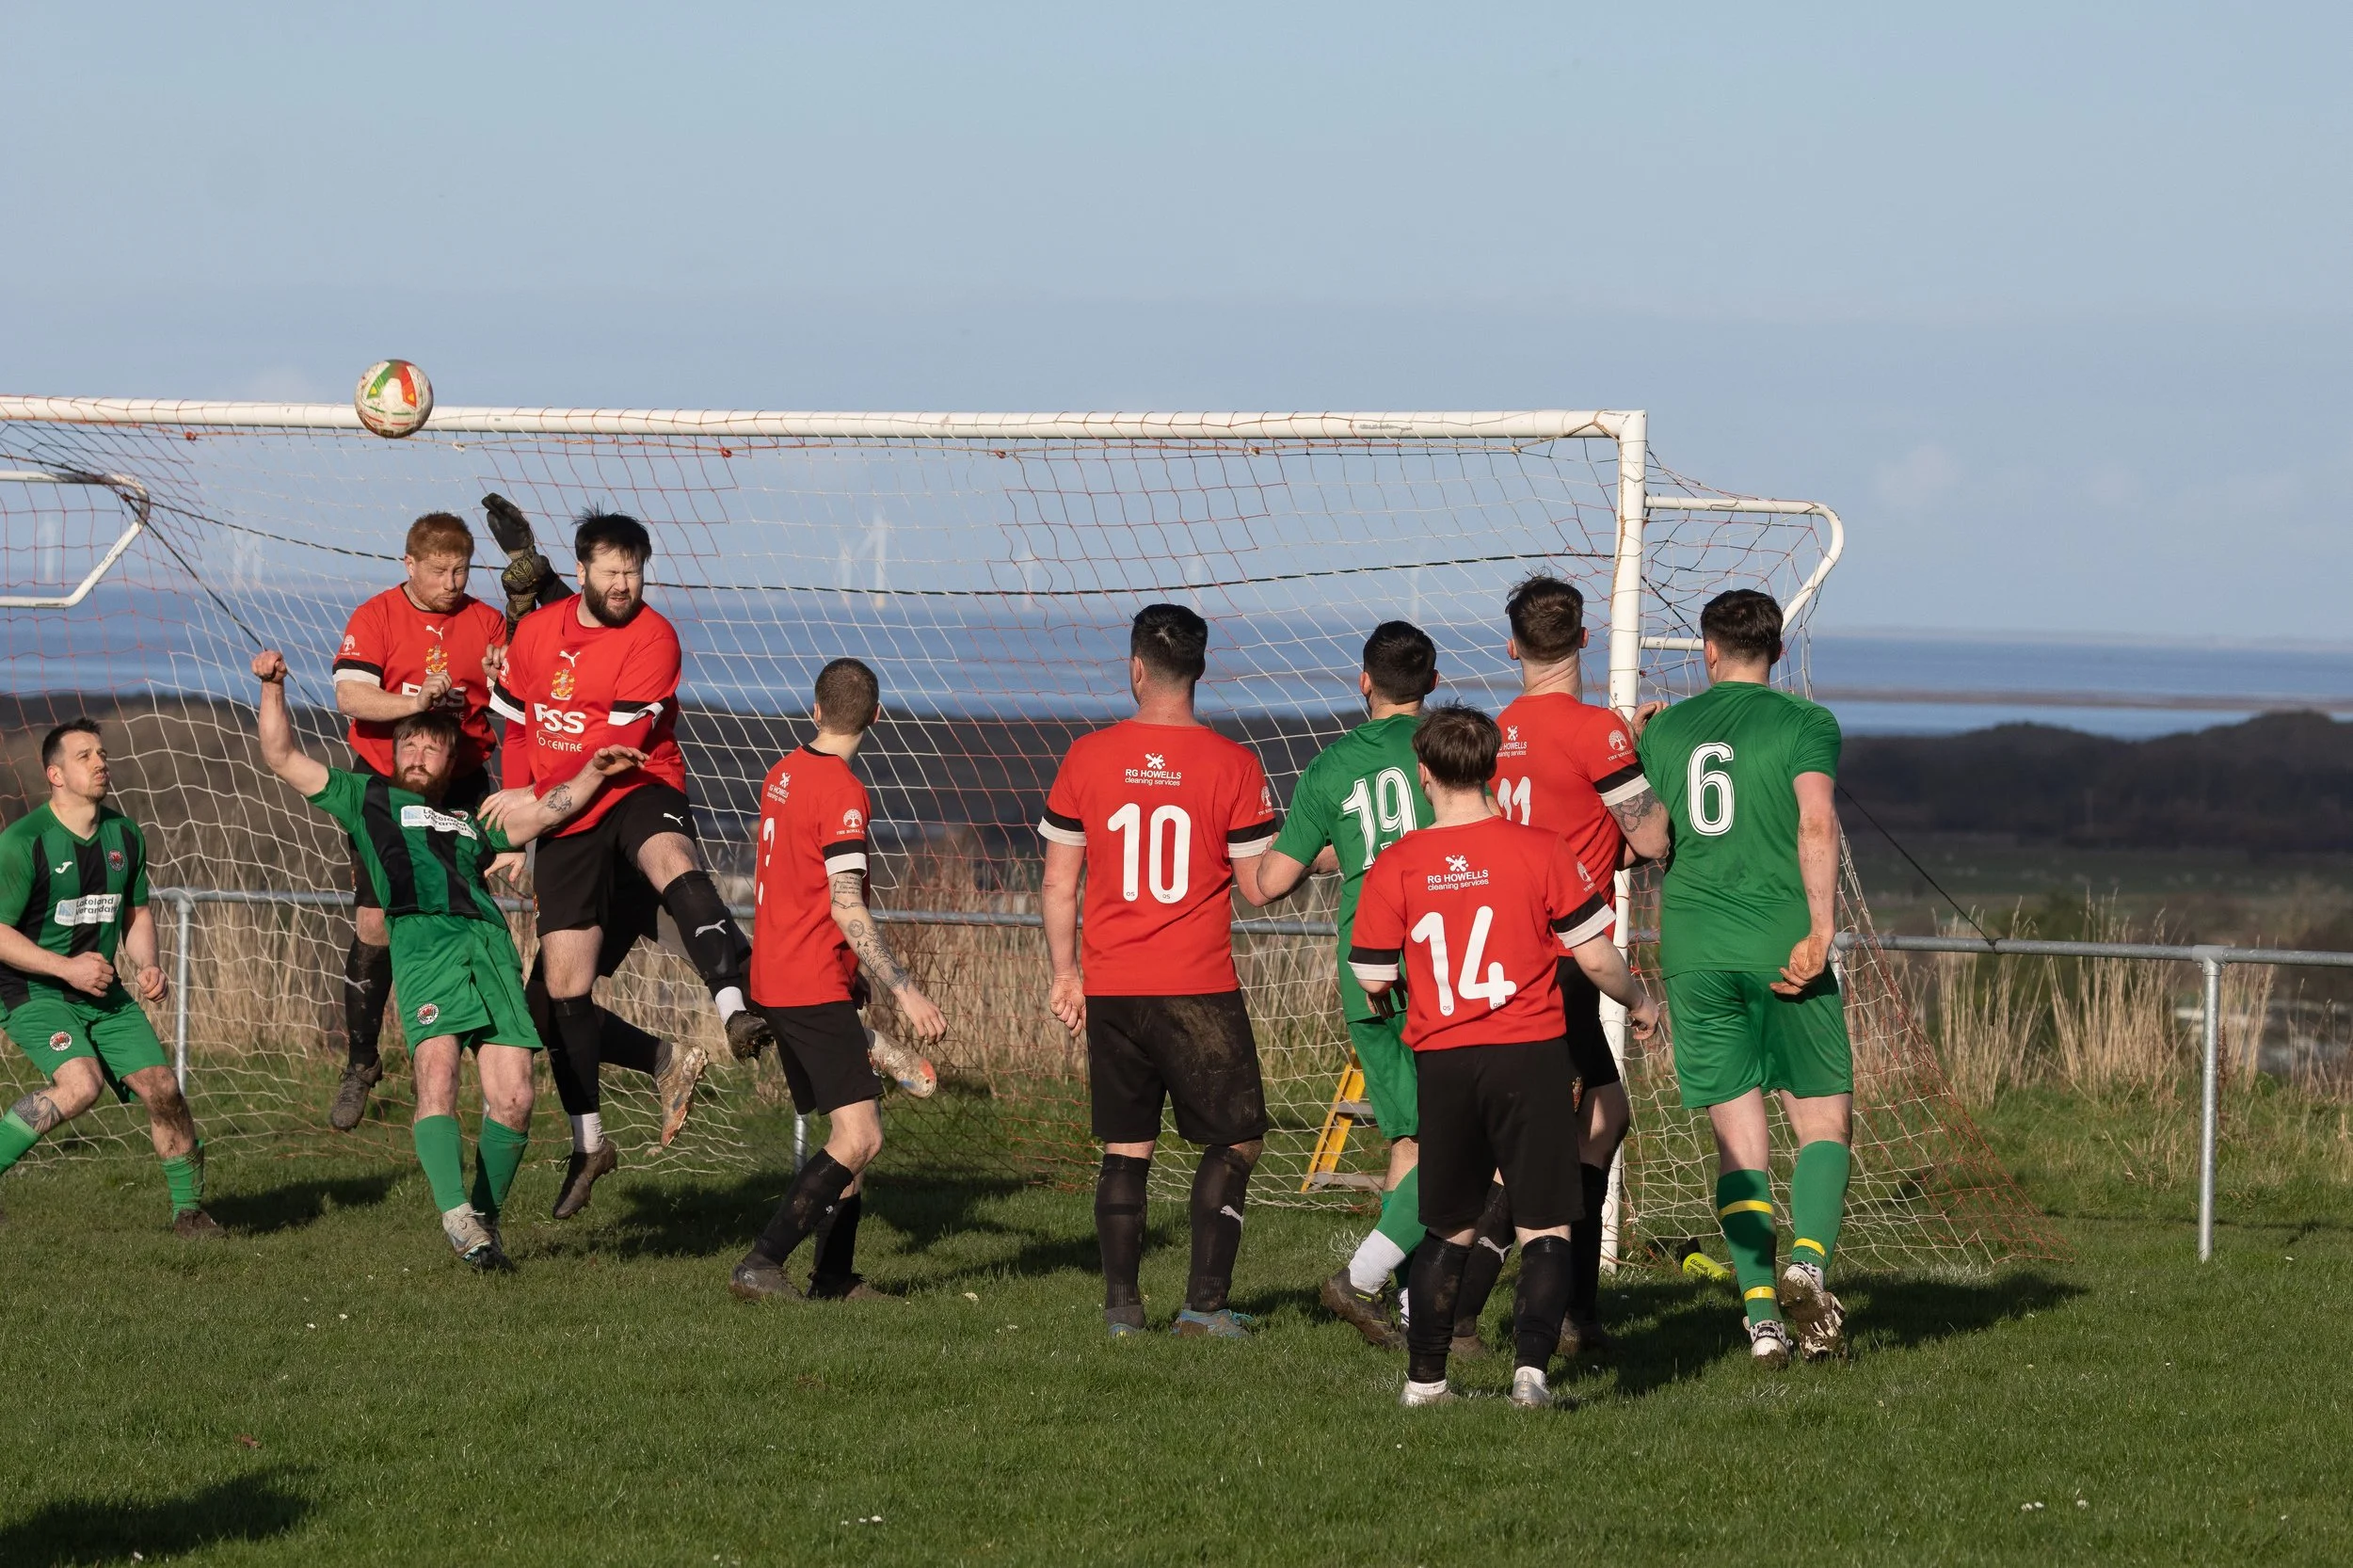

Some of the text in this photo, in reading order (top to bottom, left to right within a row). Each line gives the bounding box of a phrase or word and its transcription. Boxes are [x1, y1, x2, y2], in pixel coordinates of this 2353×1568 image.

[1125, 768, 1182, 780] RG HOWELLS
[1125, 776, 1153, 787] cleaning
[1688, 742, 1735, 836] 6
[1340, 766, 1417, 871] 19
[1497, 776, 1531, 826] 11
[1107, 803, 1192, 904] 10
[1427, 869, 1489, 885] RG HOWELLS
[1427, 878, 1489, 891] cleaning services
[1410, 905, 1517, 1016] 14
